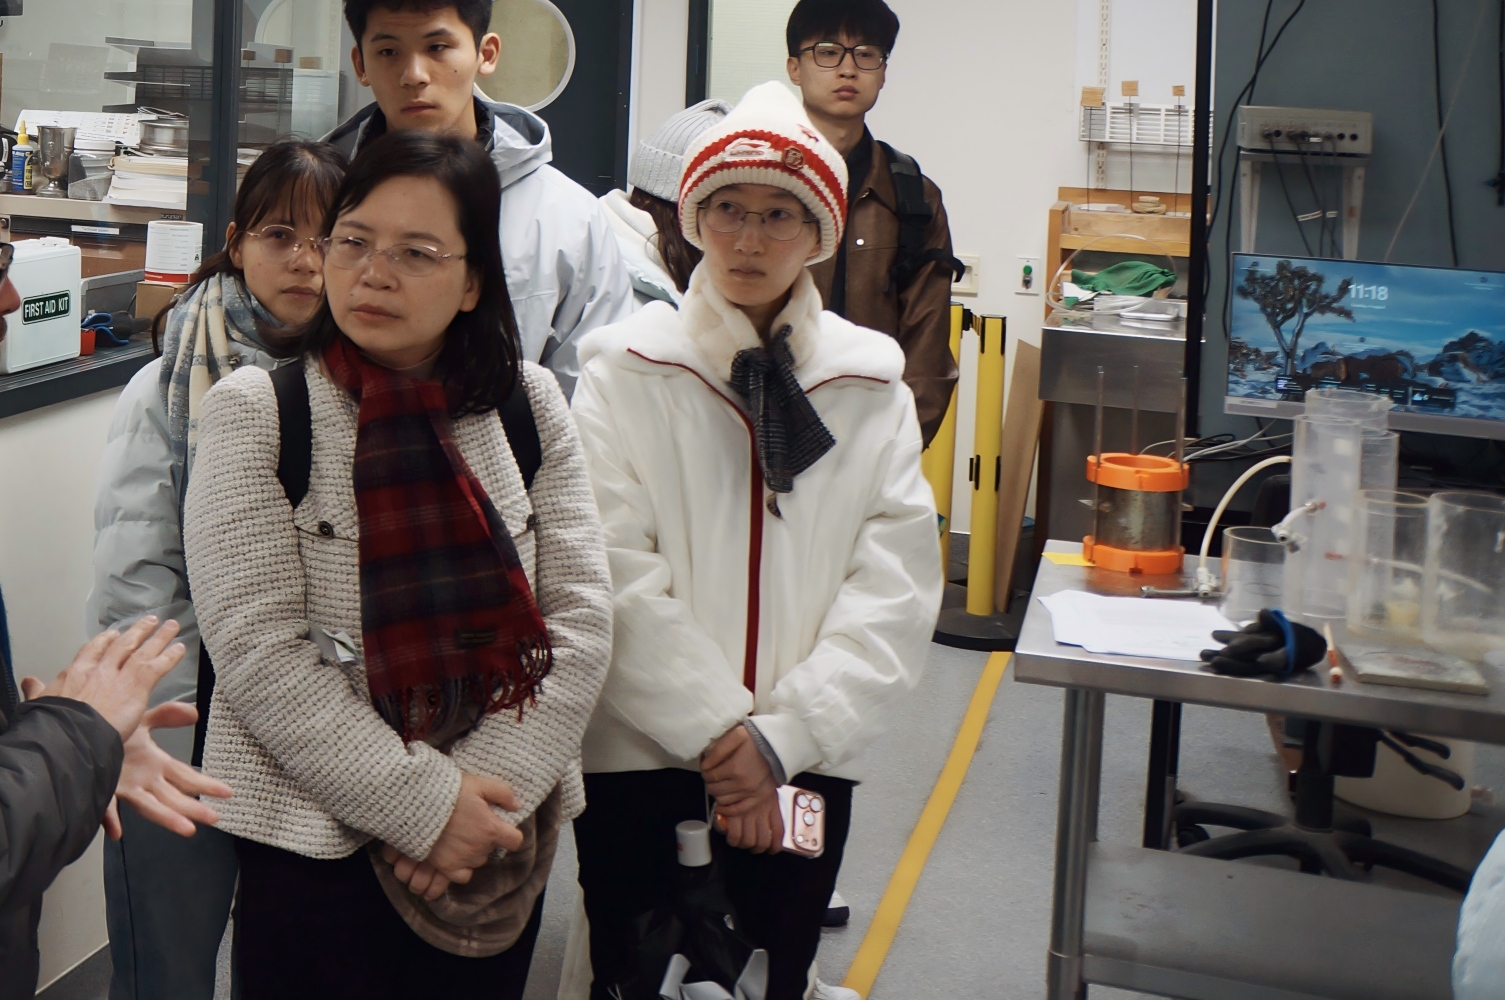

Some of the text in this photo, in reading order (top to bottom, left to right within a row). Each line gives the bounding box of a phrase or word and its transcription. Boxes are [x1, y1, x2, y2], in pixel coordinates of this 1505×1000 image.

[1348, 283, 1388, 300] 11:18
[25, 297, 68, 318] FIRST AID KIT
